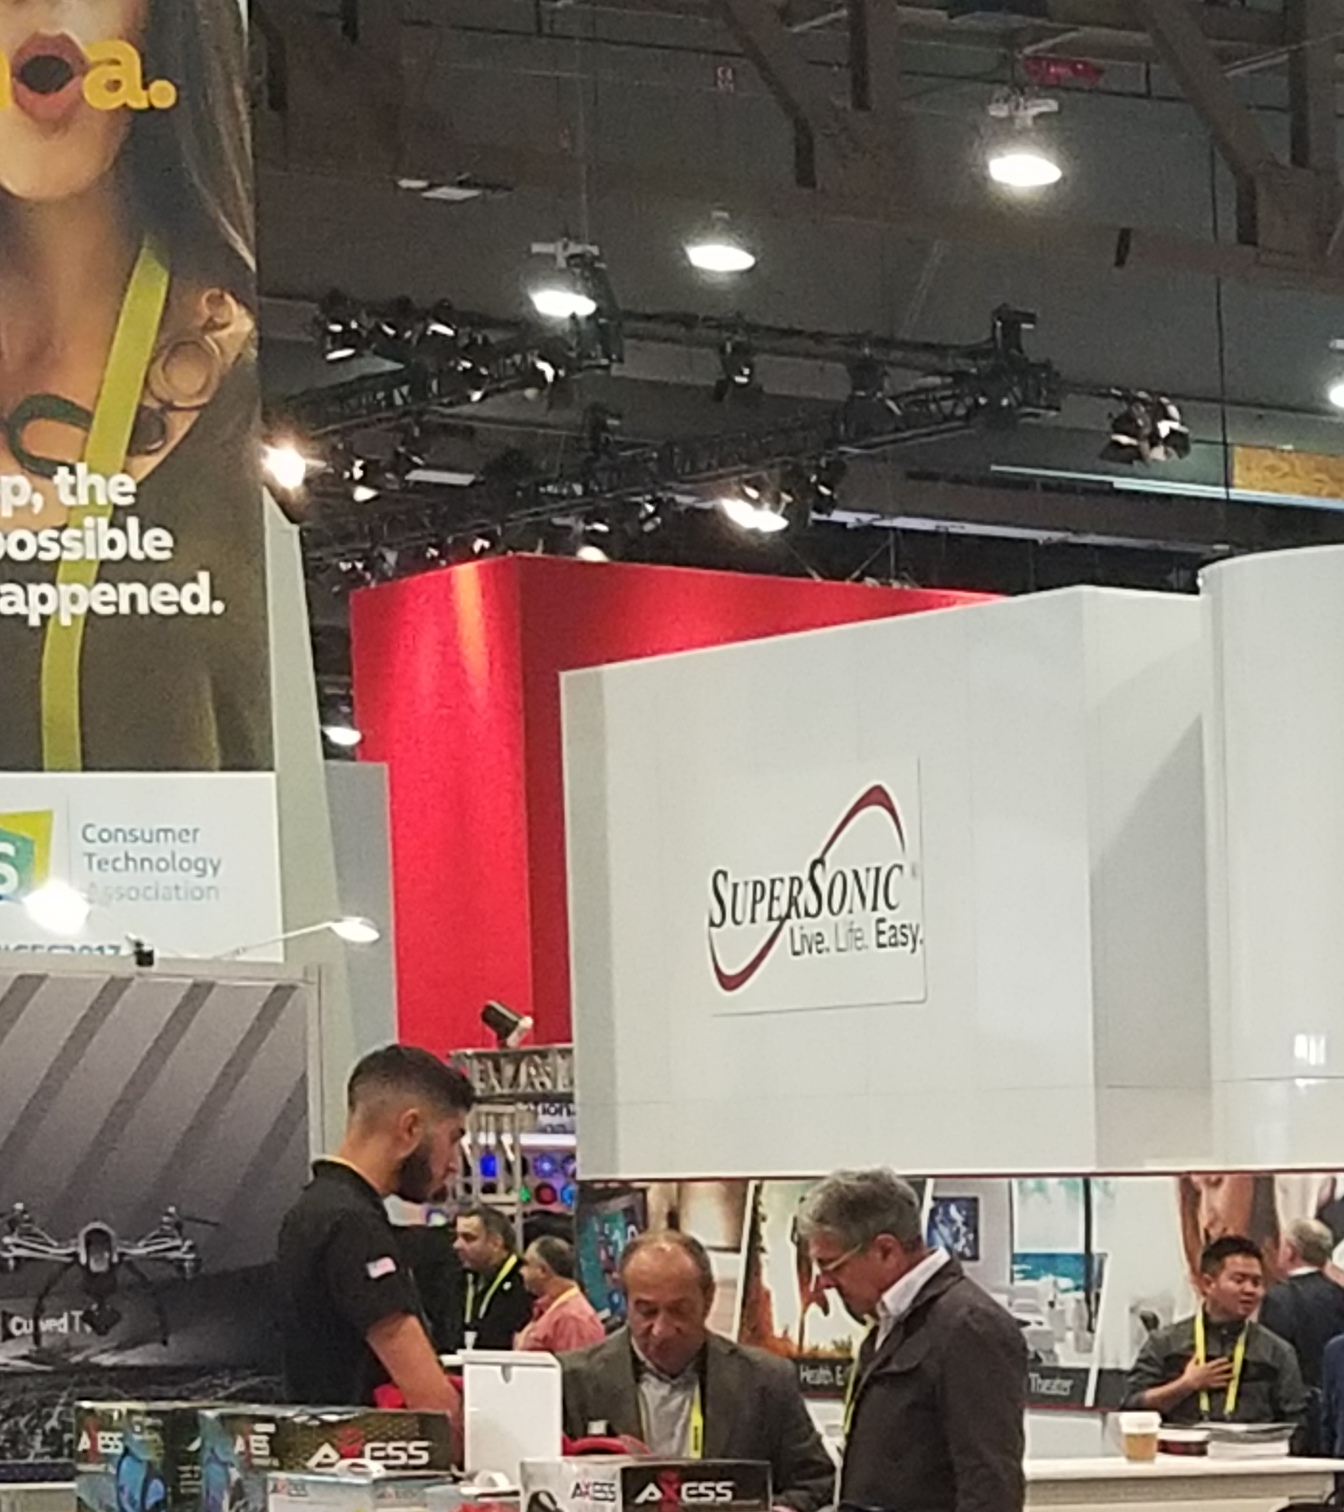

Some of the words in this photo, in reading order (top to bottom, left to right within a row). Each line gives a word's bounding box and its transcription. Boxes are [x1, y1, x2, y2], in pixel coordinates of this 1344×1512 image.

[54, 463, 137, 505] the
[0, 516, 174, 560] ossible
[82, 823, 200, 844] Consumer
[83, 852, 222, 877] Technology
[789, 926, 830, 957] Live.
[835, 921, 869, 952] Life.
[875, 917, 924, 953] Easy.
[9, 1311, 68, 1336] Cuved
[634, 1480, 735, 1504] AXESS
